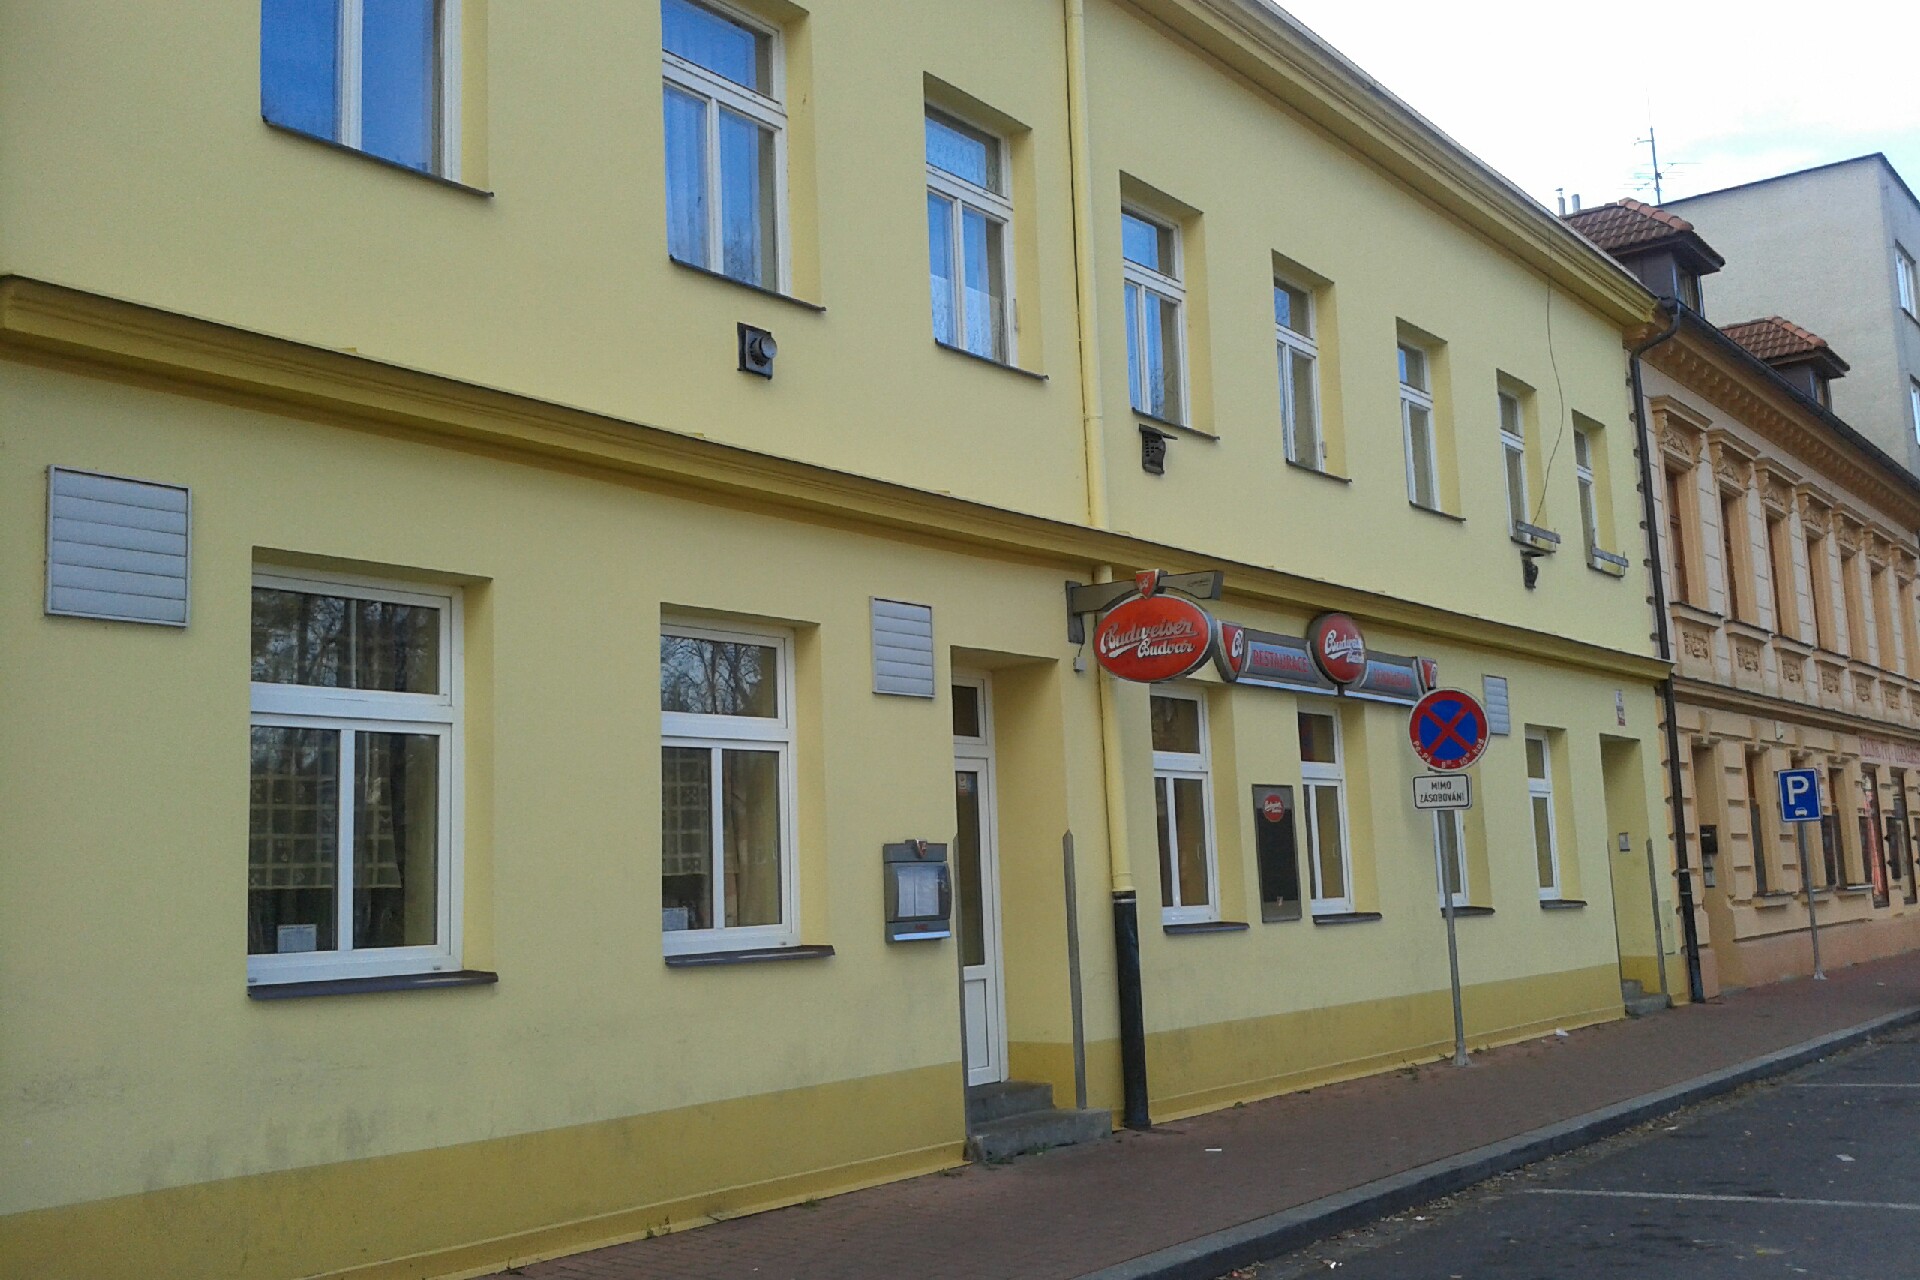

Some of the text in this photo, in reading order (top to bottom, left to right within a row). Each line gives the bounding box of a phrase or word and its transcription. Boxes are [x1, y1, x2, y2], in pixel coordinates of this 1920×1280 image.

[1099, 617, 1198, 657] Budweiser
[1137, 638, 1195, 657] Budvar
[1253, 649, 1308, 673] RESTAURACE
[1431, 780, 1452, 790] MIMO
[1786, 775, 1809, 805] P
